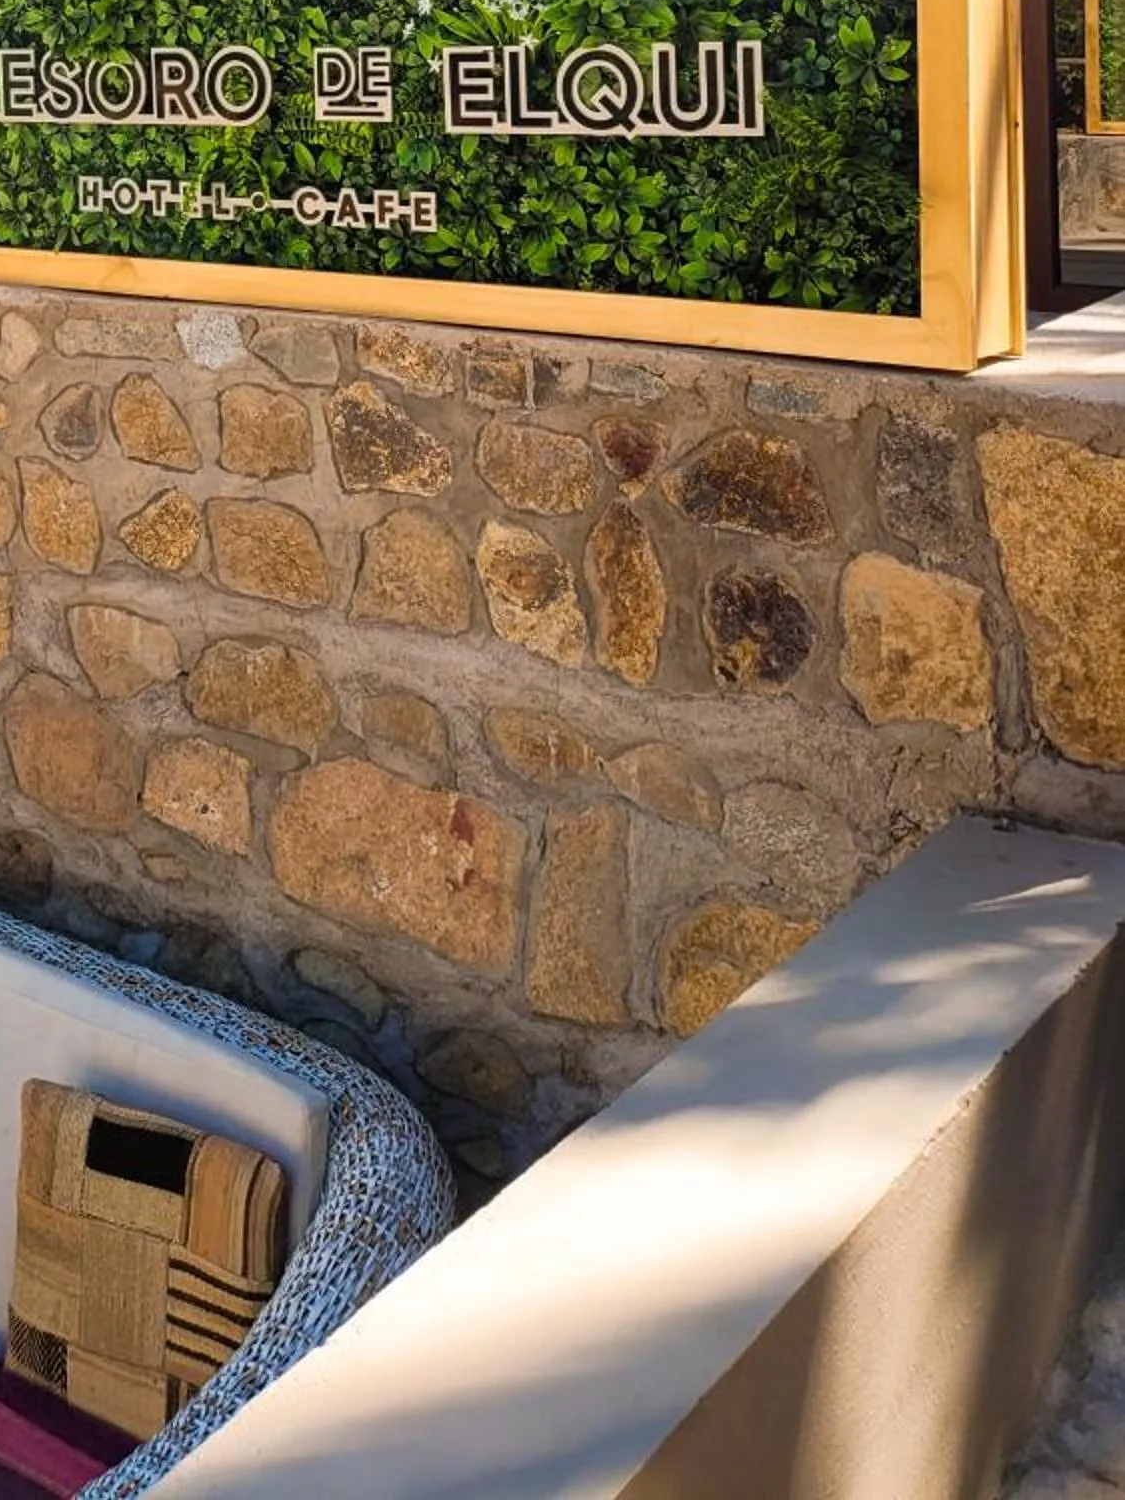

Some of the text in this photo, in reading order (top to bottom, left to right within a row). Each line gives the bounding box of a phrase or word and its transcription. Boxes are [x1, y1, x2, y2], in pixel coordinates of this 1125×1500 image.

[315, 47, 392, 116] DE
[442, 40, 764, 138] ELQUI
[293, 186, 437, 232] CAFE
